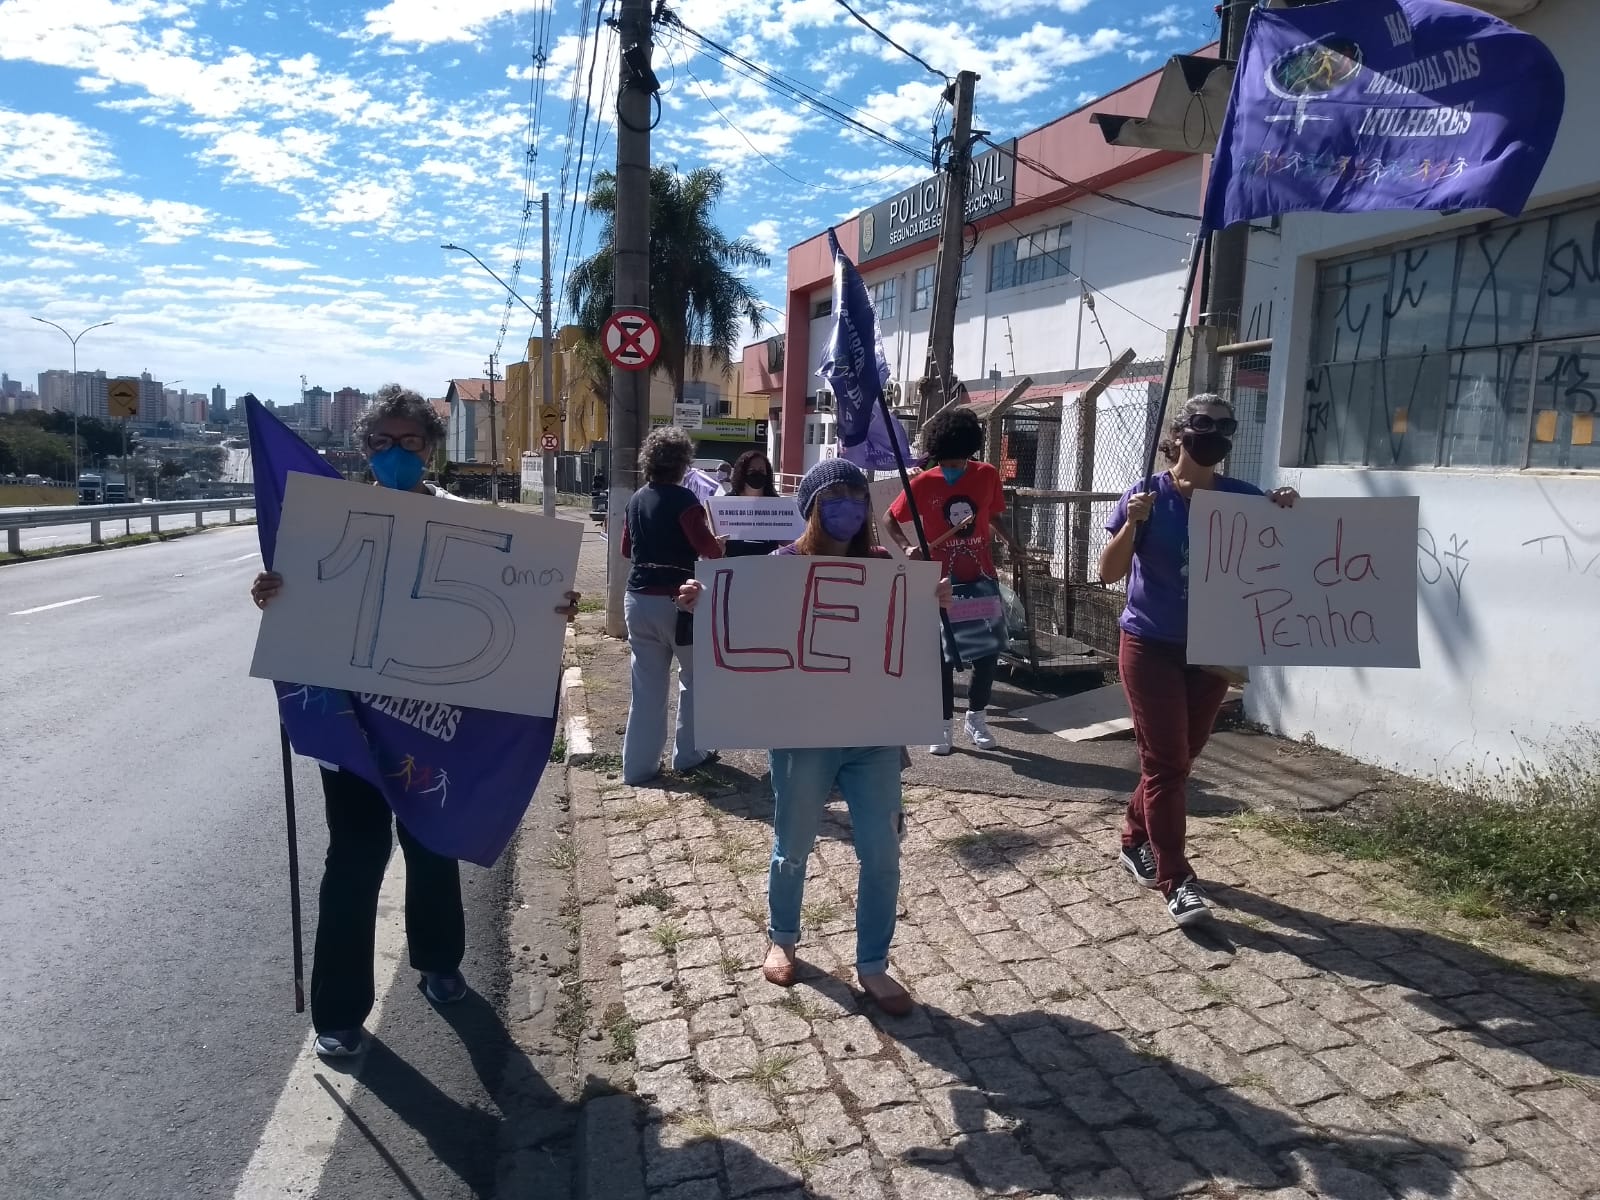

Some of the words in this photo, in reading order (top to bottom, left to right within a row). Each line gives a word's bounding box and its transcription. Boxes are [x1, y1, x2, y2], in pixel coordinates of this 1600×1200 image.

[1363, 56, 1447, 94] MUNDIAL
[1443, 42, 1481, 84] DAS
[1358, 101, 1475, 138] MULHERES
[889, 181, 944, 228] POLÍCI
[968, 151, 1006, 195] IVIL
[889, 224, 918, 245] SEGUNDA
[919, 215, 942, 233] DELEG
[963, 187, 1004, 216] ECCIONAL
[945, 539, 966, 548] LULA
[1313, 518, 1379, 587] da
[318, 510, 515, 686] 15
[712, 561, 908, 678] LEI
[1242, 588, 1381, 656] Penha
